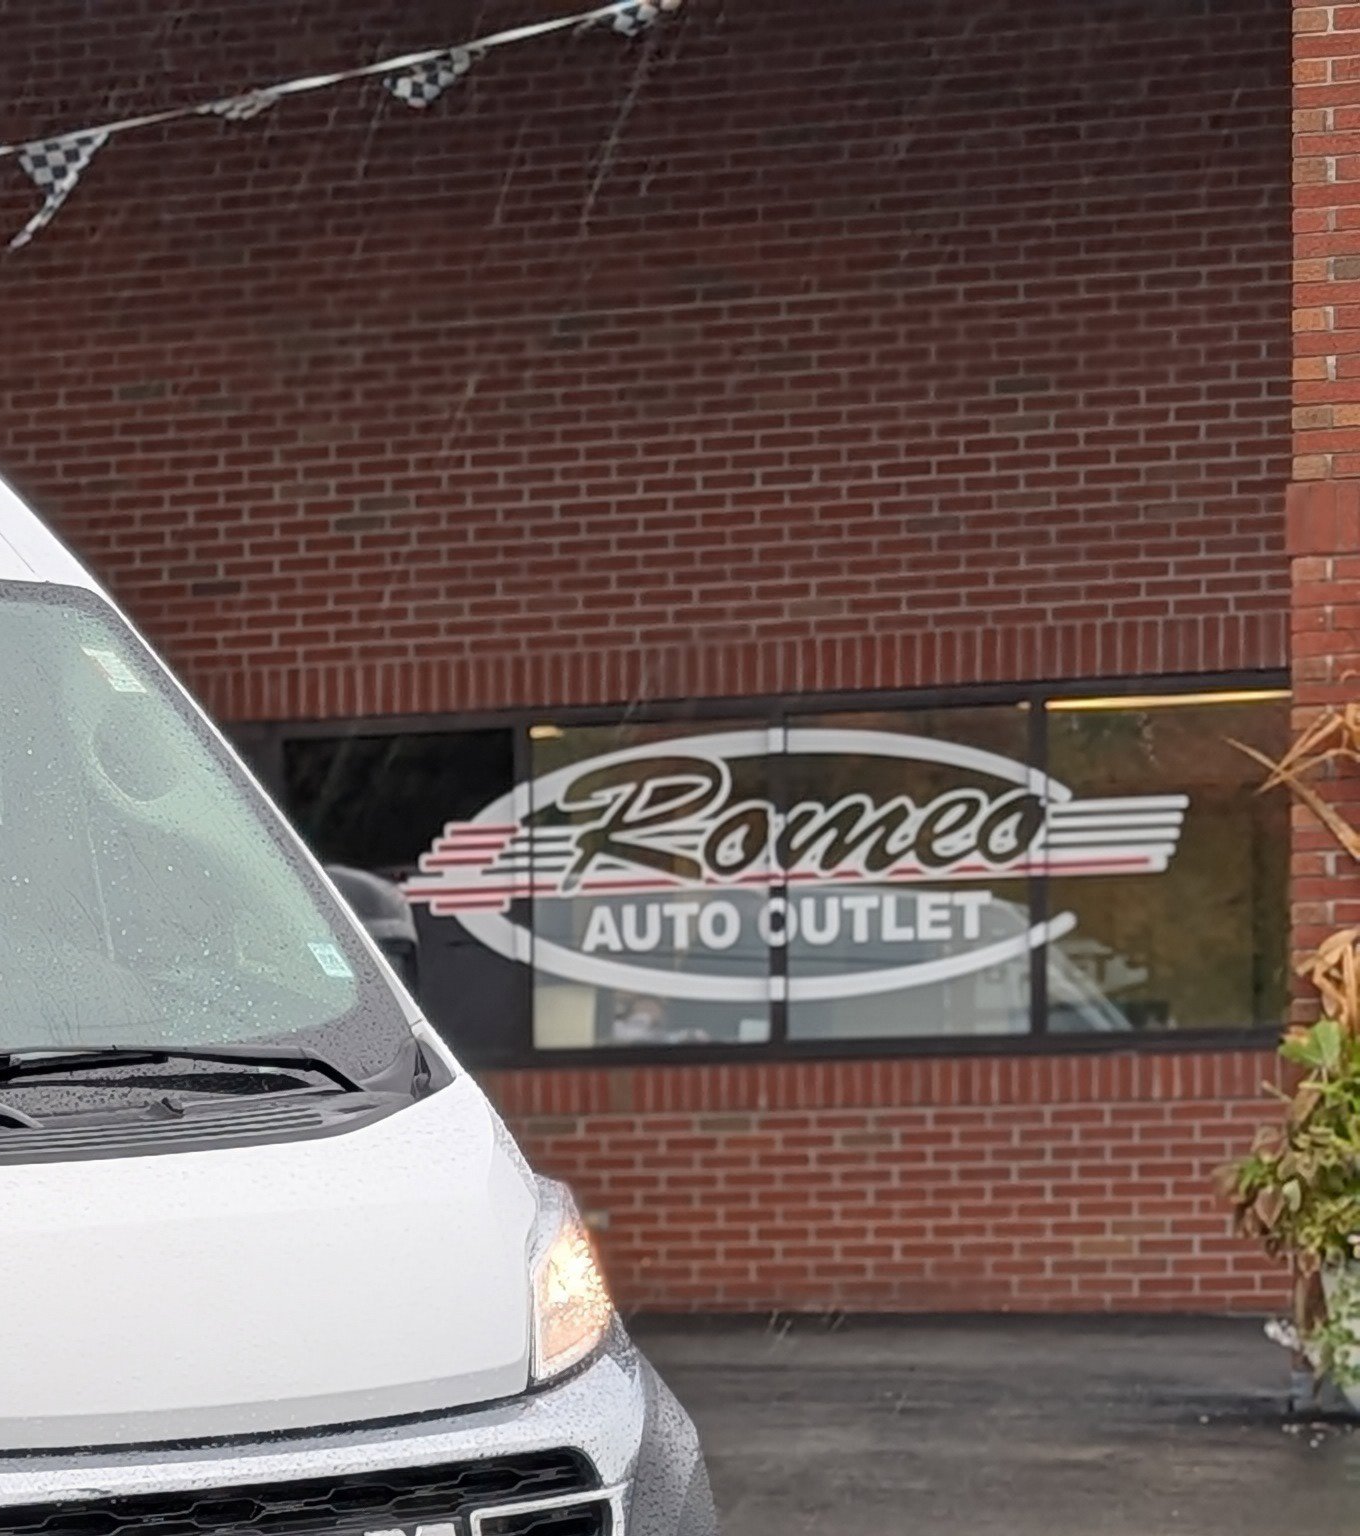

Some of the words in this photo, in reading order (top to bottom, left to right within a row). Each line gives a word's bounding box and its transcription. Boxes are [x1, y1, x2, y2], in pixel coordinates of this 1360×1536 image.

[557, 755, 1050, 896] Romeo
[582, 902, 742, 953] AUTO
[758, 891, 991, 947] OUTLET
